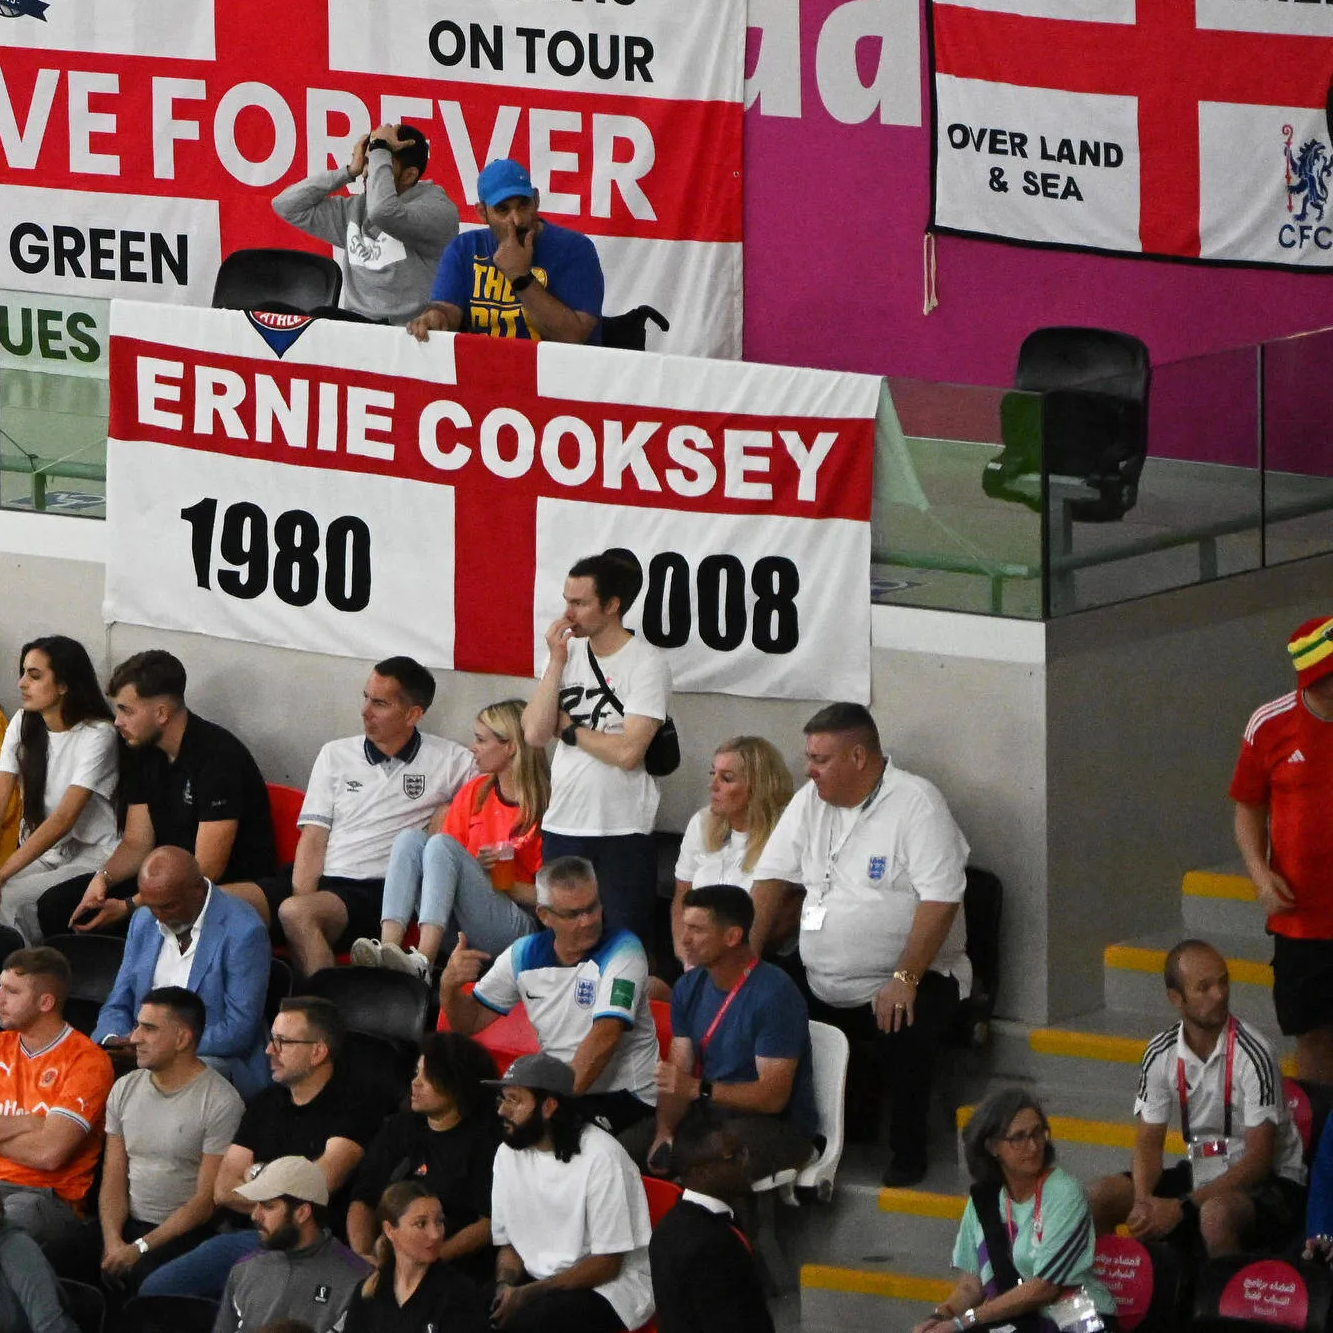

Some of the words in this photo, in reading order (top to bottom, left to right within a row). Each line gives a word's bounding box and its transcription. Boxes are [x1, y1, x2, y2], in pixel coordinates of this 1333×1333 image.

[429, 19, 504, 71] ON
[516, 28, 654, 83] TOUR
[946, 123, 1029, 159] OVER
[1039, 136, 1124, 169] LAND
[988, 166, 1009, 194] &
[1022, 169, 1084, 202] SEA
[9, 221, 189, 286] GREEN
[1278, 223, 1333, 250] CFC
[135, 355, 396, 461] ERNIE
[418, 397, 841, 503] COOKSEY
[179, 497, 372, 614] 1980
[601, 547, 801, 656] 008
